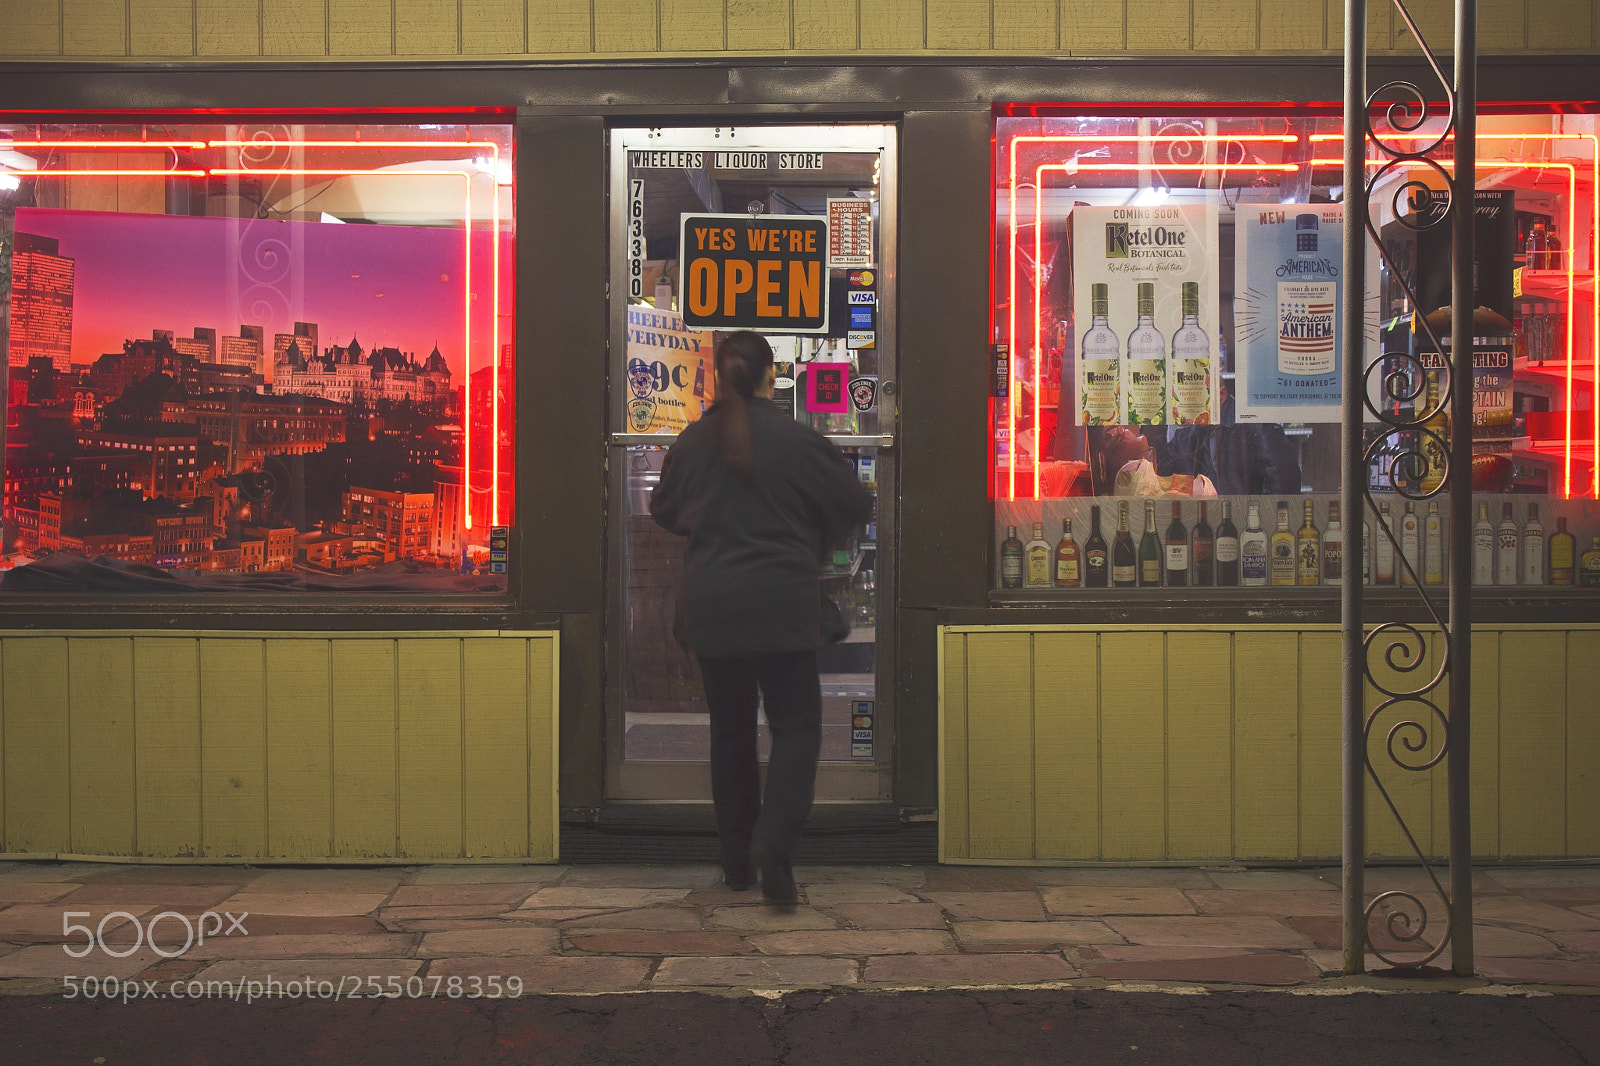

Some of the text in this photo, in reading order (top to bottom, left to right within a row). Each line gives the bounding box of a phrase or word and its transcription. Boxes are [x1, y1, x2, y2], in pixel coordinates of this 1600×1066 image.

[634, 152, 822, 168] WHEELERS LIQUOR STORE
[1113, 209, 1179, 219] COMING SOON
[1259, 211, 1285, 225] NEW
[695, 227, 736, 251] YES
[747, 229, 817, 252] WE'RE
[1107, 225, 1186, 255] Ketel One
[1131, 249, 1186, 258] BOTANICAL
[1276, 258, 1338, 277] AMERICAN
[689, 257, 820, 318] OPEN
[851, 293, 874, 302] VISA
[1280, 311, 1332, 325] American
[1282, 322, 1331, 338] ANTHEM
[1483, 374, 1499, 386] the
[658, 397, 687, 407] bottles
